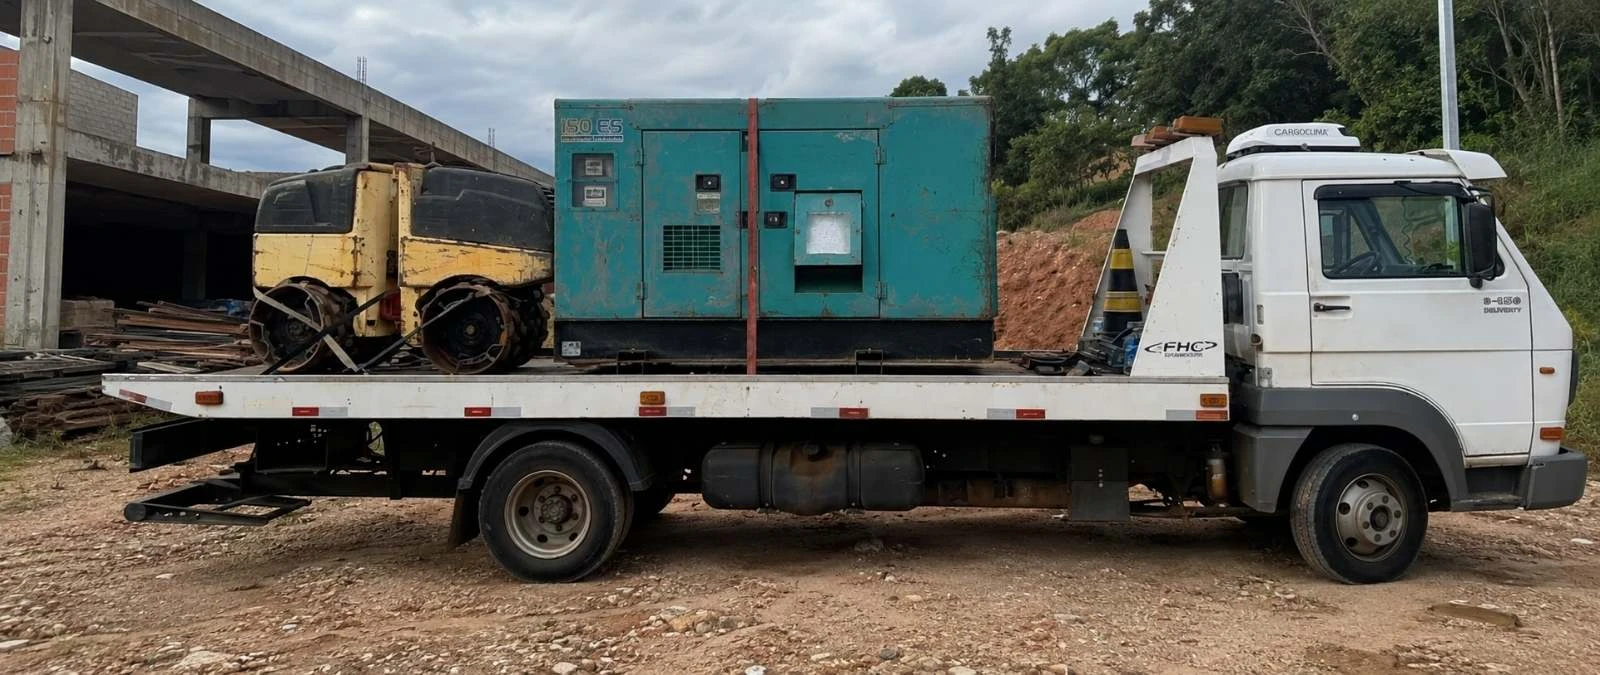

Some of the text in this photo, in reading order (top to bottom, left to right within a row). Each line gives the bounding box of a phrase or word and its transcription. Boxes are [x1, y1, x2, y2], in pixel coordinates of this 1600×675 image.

[560, 118, 623, 135] 150 ES
[1274, 128, 1328, 136] CARGOCLIMA
[1163, 341, 1204, 352] FHC
